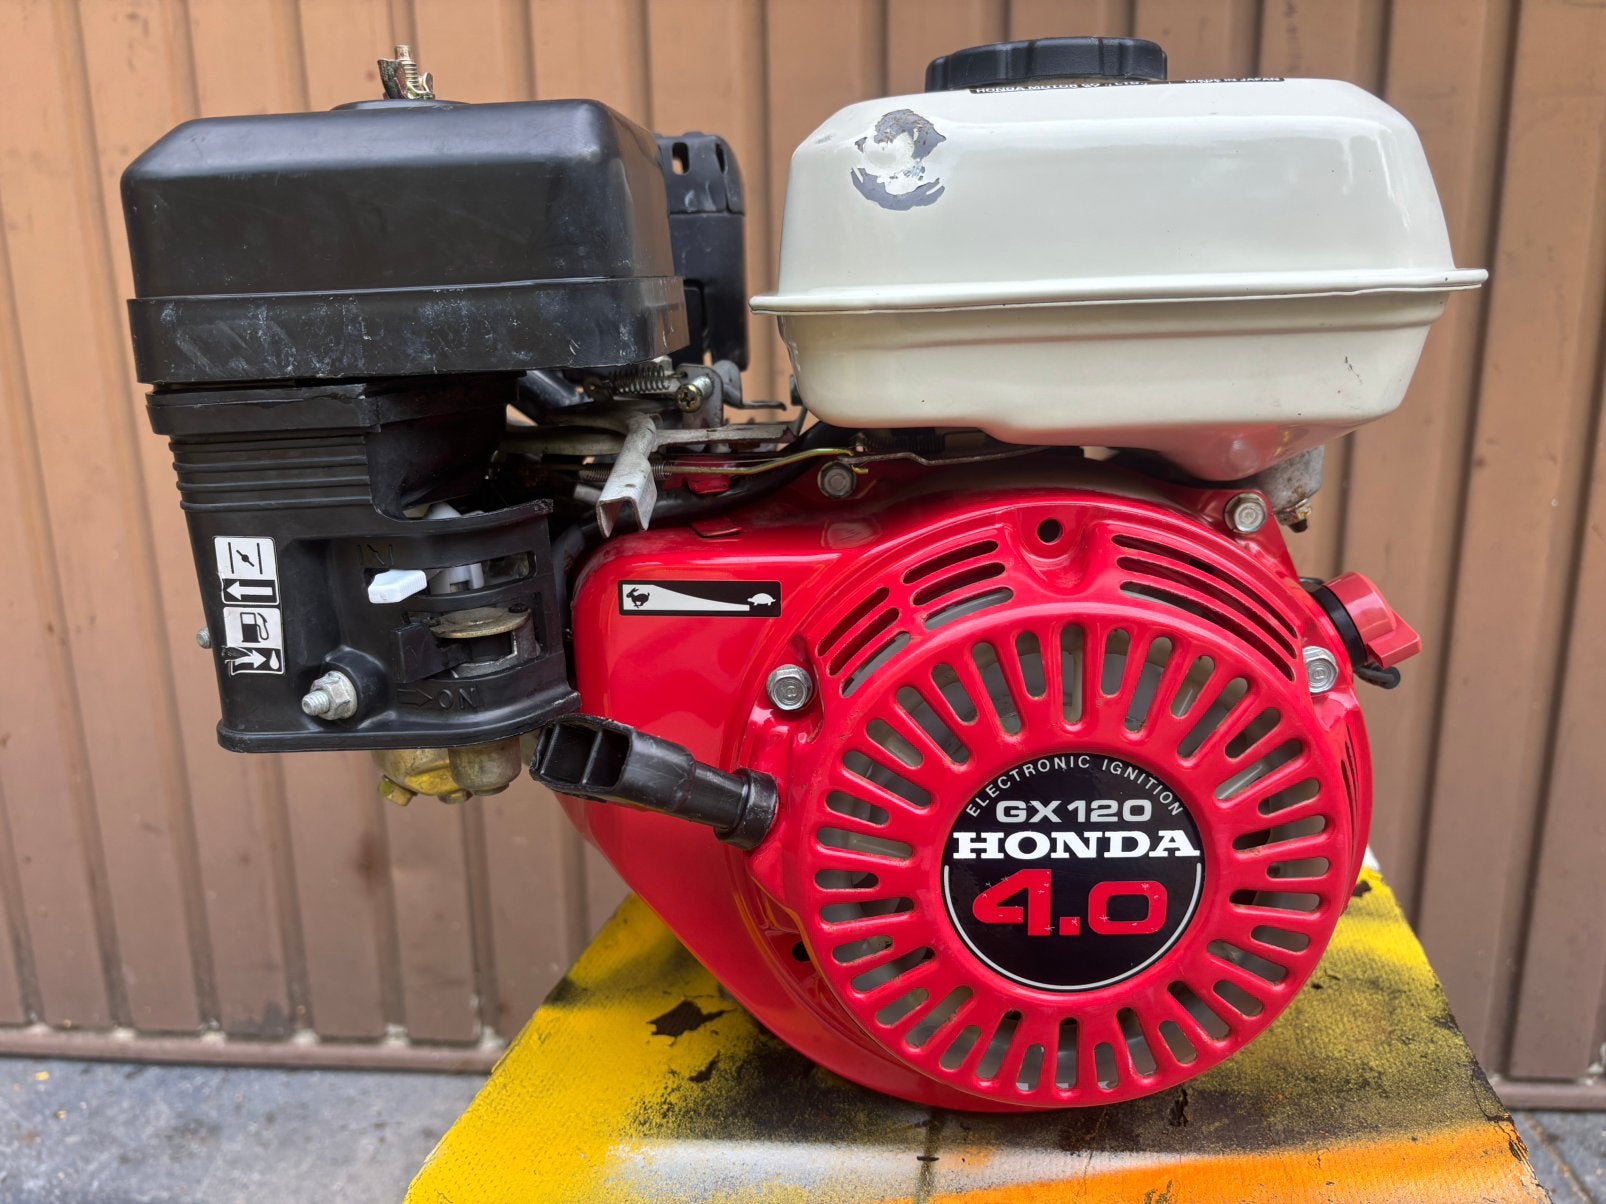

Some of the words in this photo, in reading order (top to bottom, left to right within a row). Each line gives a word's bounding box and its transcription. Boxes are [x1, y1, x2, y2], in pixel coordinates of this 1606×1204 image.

[438, 687, 477, 709] ON
[966, 755, 1090, 817] ELECTRONIC
[1102, 759, 1184, 816] IGNITION
[952, 830, 1200, 859] HONDA
[972, 869, 1168, 936] 4.0
